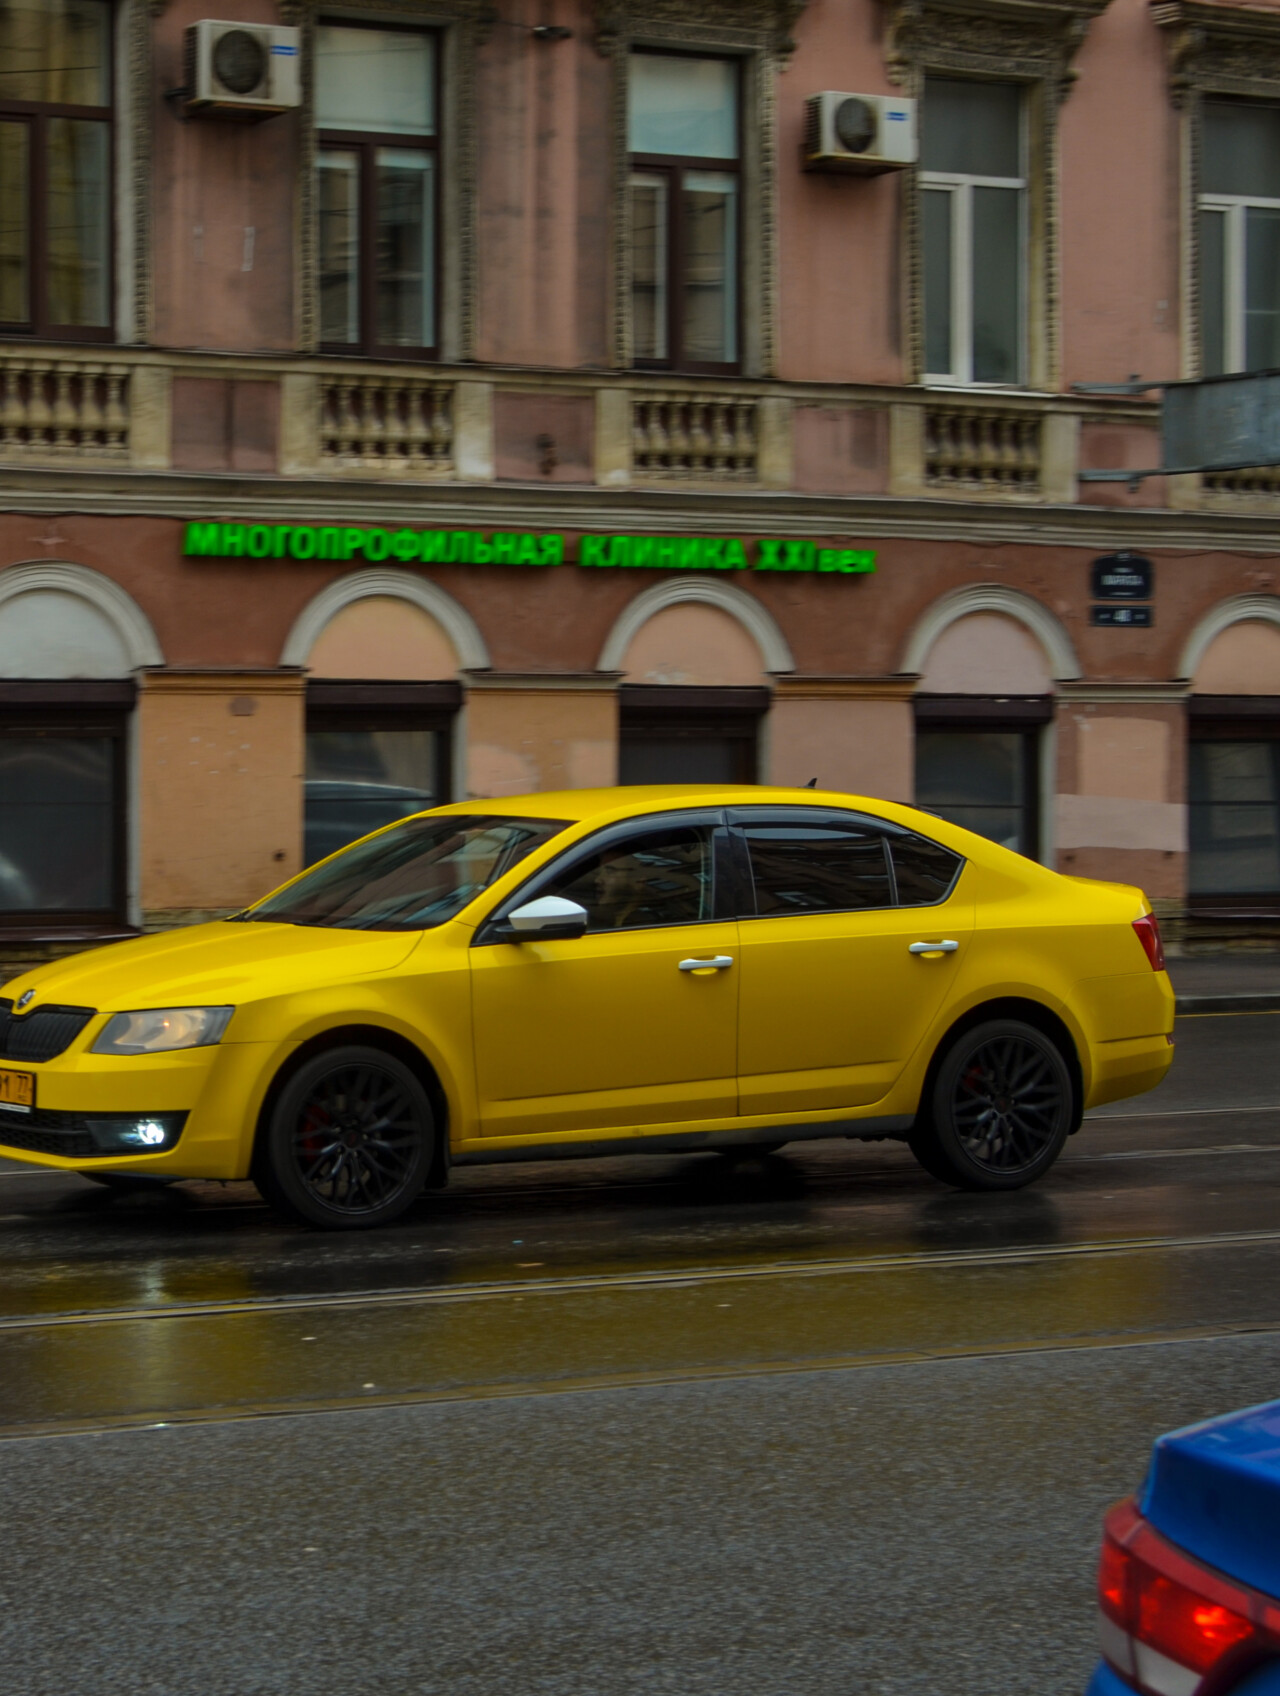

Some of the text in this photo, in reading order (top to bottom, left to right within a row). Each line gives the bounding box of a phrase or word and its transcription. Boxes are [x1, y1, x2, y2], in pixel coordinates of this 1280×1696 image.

[183, 521, 564, 566] МНОГОПРОФИЛЬНАЯ
[578, 534, 748, 570] КЛИНИКА
[752, 538, 817, 573] XXI
